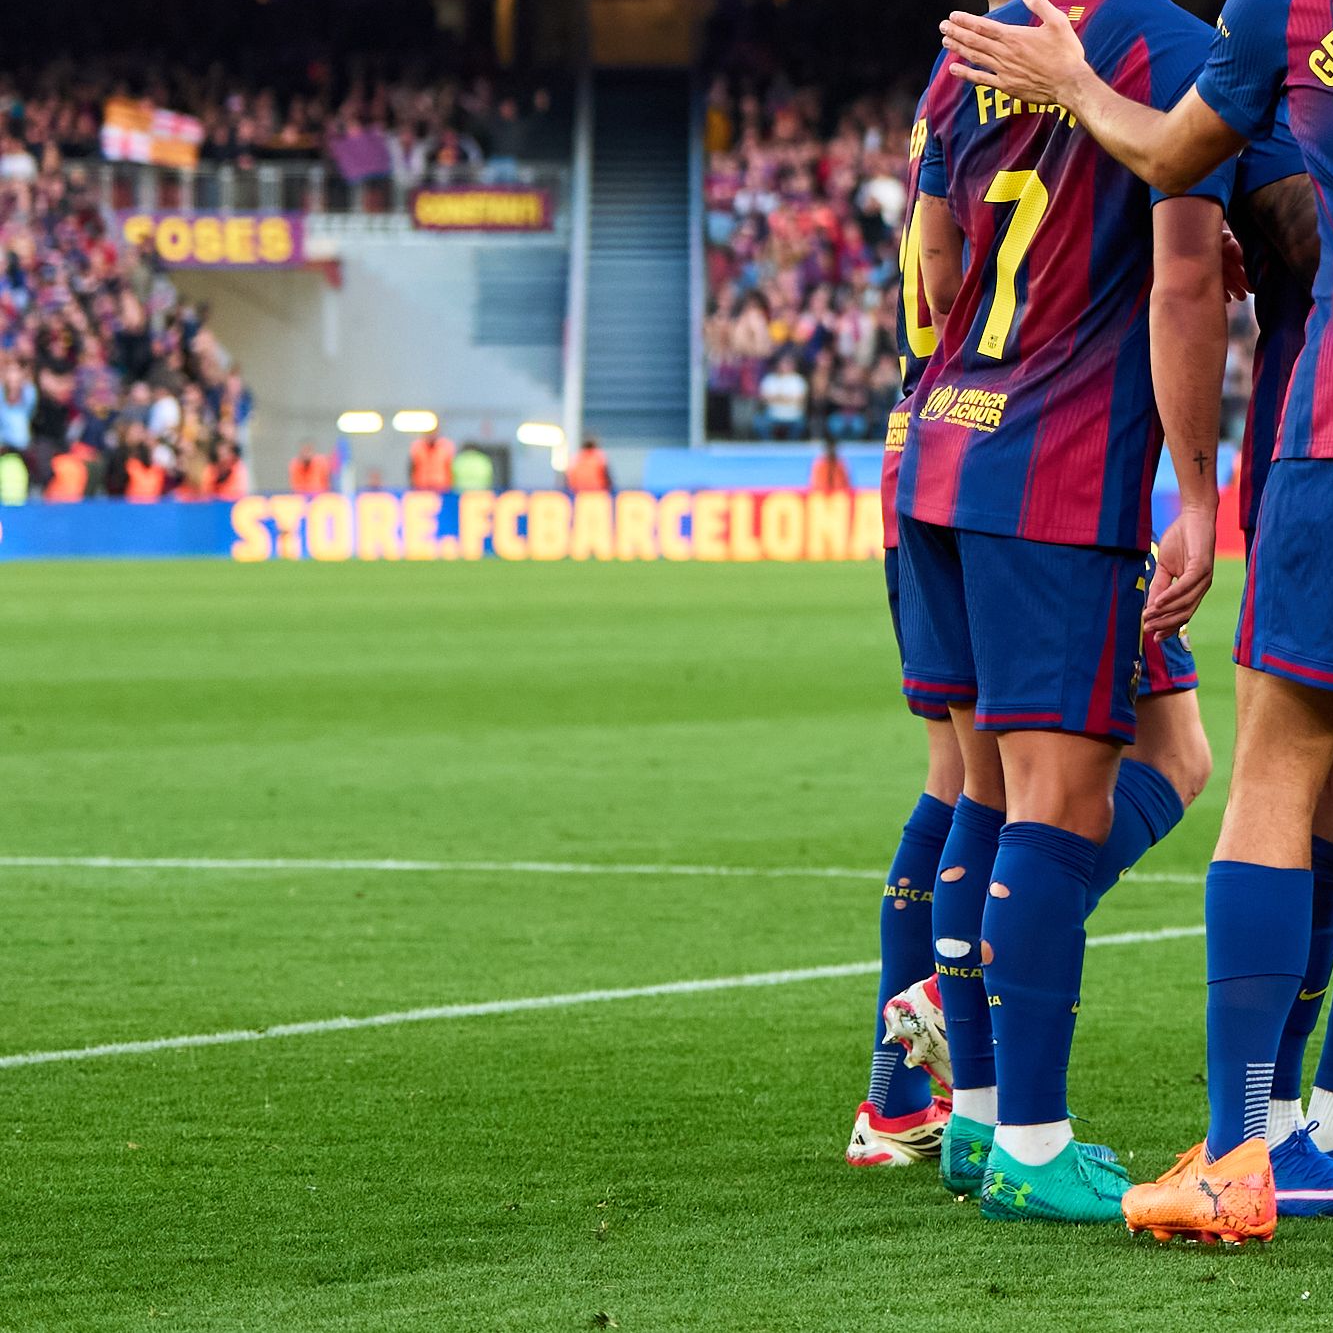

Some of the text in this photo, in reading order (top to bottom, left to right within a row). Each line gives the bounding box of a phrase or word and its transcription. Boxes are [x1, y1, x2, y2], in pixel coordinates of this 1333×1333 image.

[977, 169, 1049, 360] 7
[957, 388, 1008, 410] UNHCR
[946, 403, 1002, 427] ACNUR
